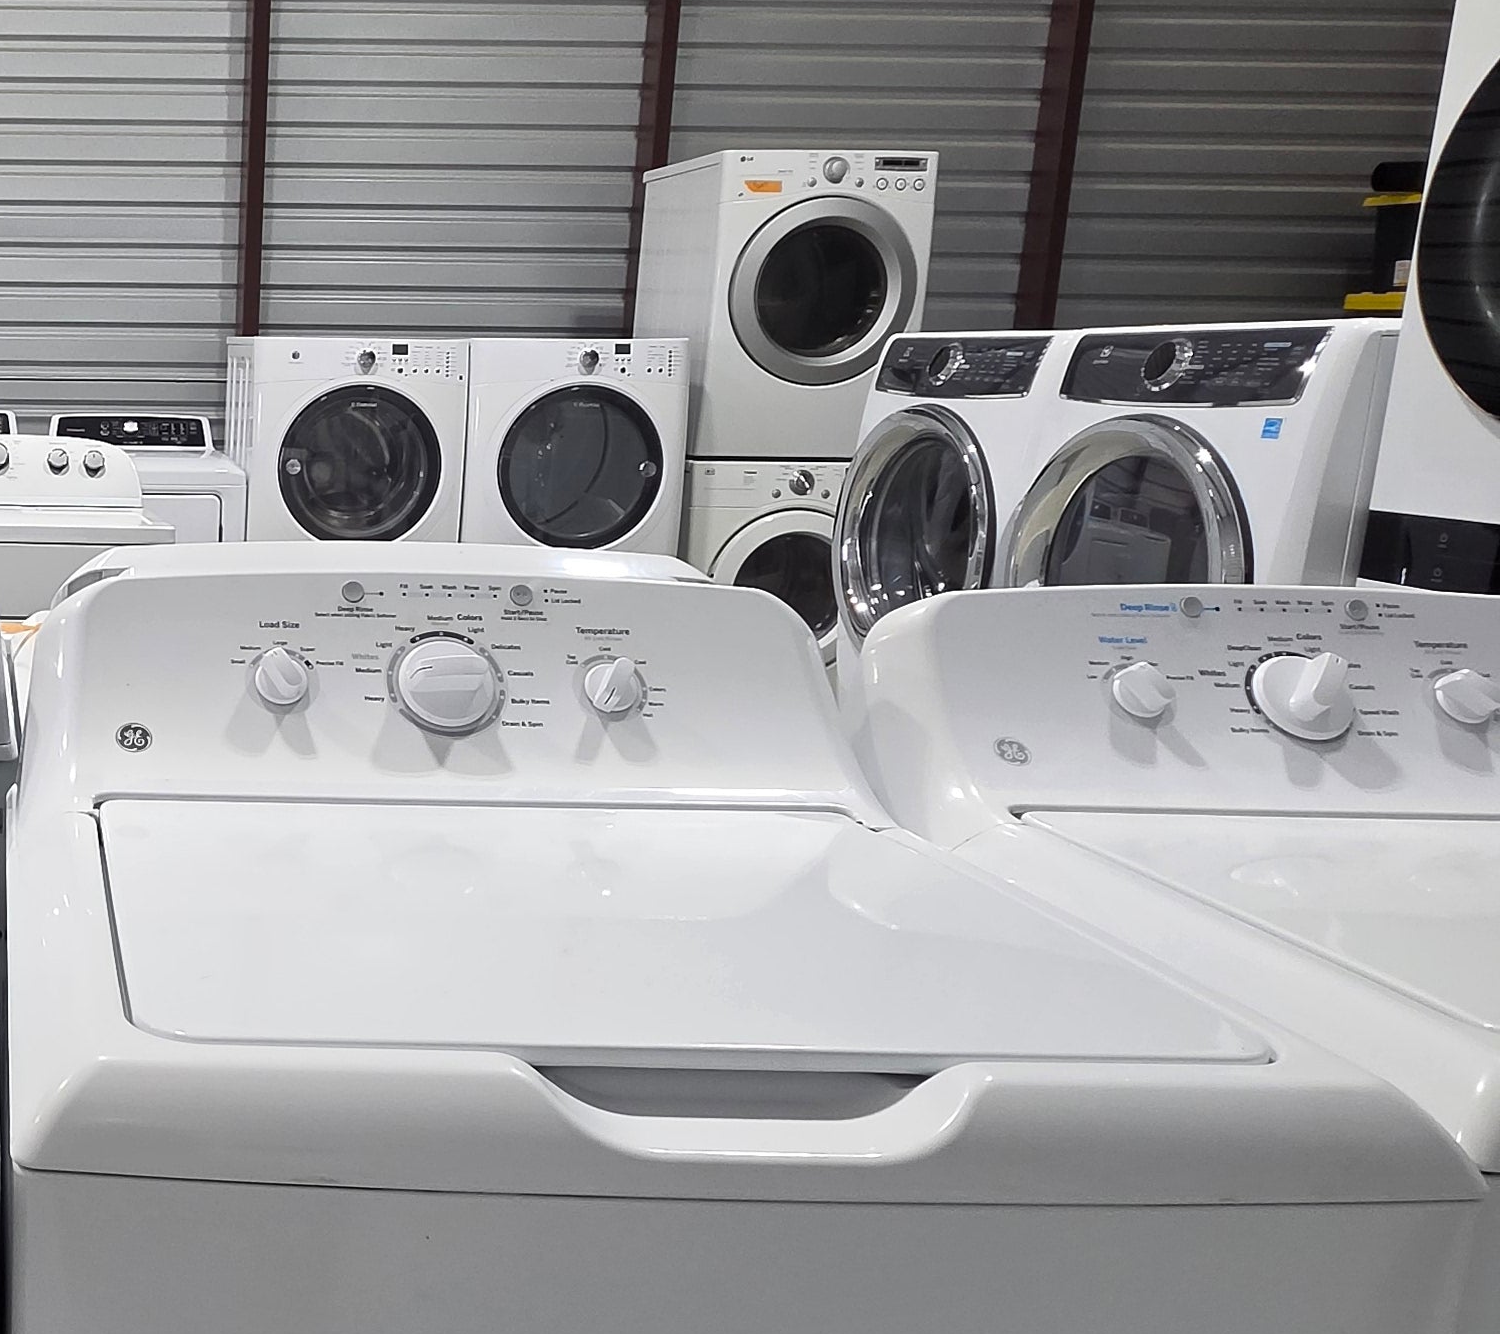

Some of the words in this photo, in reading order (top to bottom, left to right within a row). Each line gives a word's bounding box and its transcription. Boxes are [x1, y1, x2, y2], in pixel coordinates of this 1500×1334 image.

[1120, 603, 1143, 612] Deep
[1145, 603, 1169, 611] Rinse
[576, 627, 630, 636] Temperature
[1126, 636, 1147, 644] Level
[1414, 641, 1468, 649] Temperature
